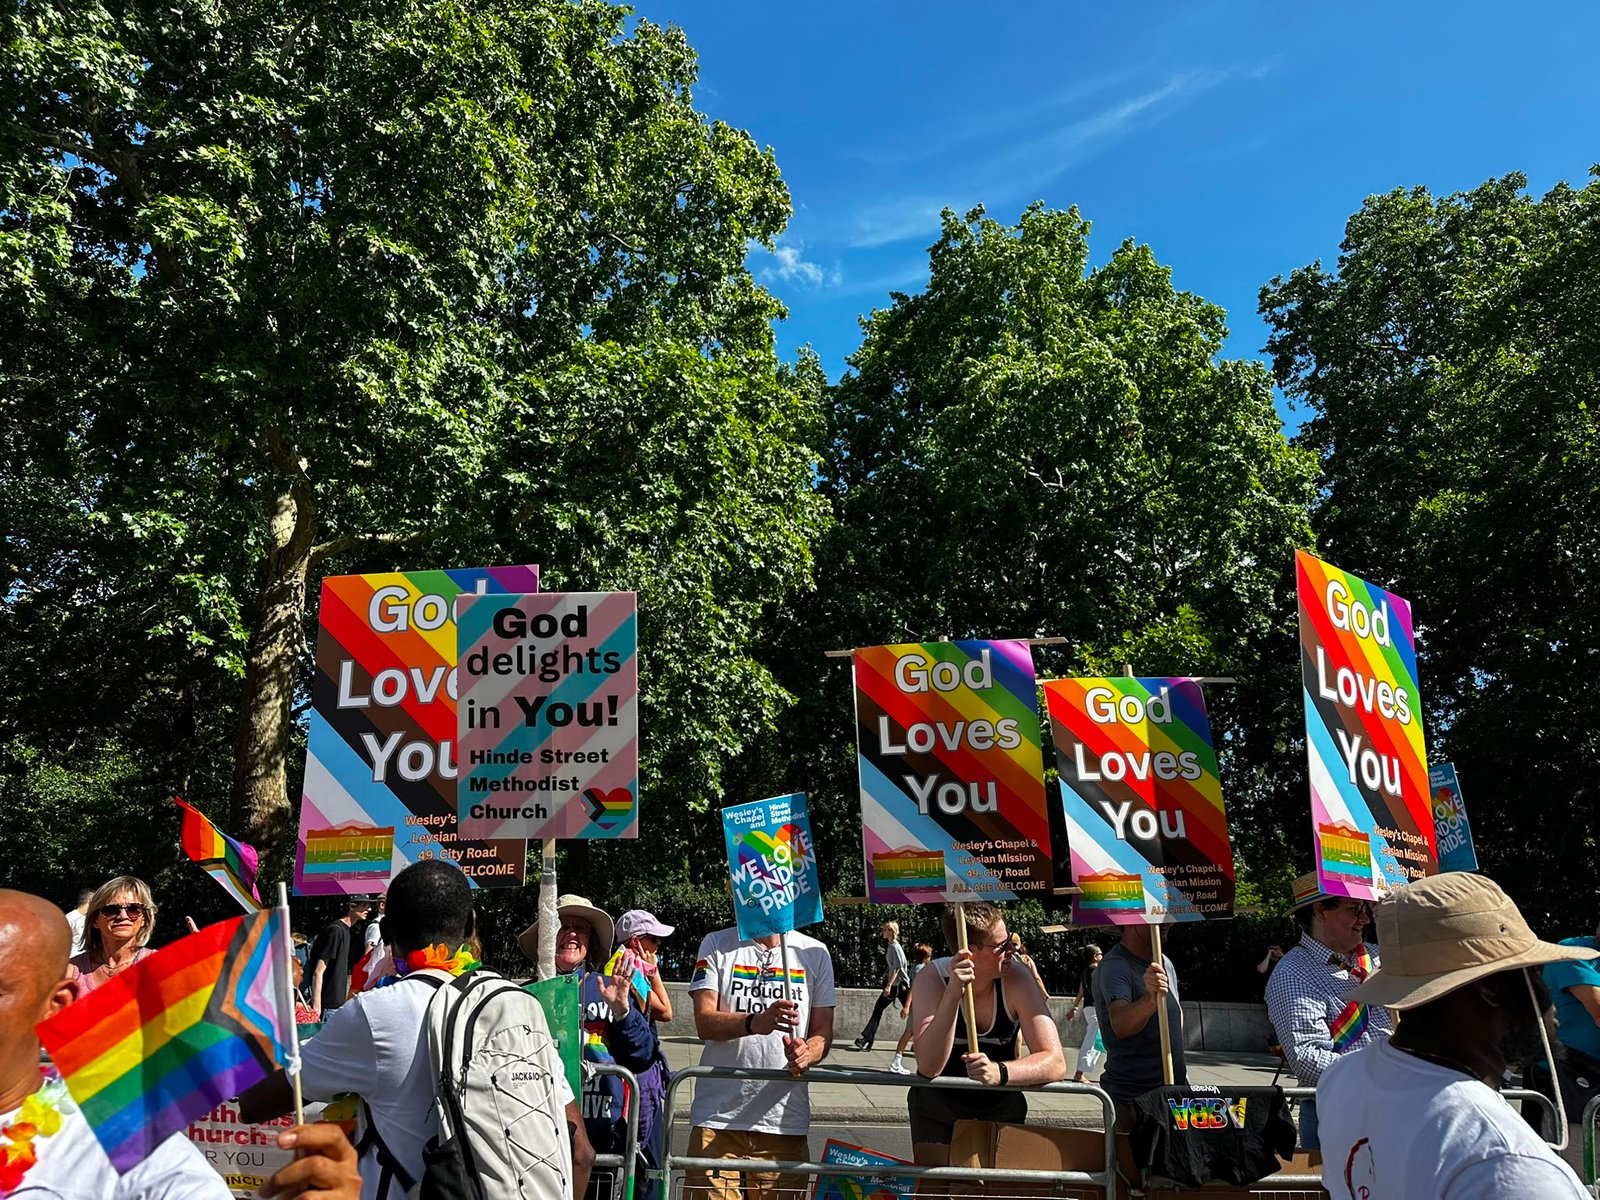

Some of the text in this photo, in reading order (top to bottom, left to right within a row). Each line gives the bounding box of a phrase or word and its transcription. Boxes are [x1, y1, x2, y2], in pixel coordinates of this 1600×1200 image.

[492, 605, 588, 639] God
[1326, 579, 1391, 649] God
[466, 644, 622, 683] delights
[894, 648, 993, 694] God
[1316, 645, 1412, 726] Loves
[467, 695, 619, 729] in You!
[1084, 686, 1174, 725] God
[878, 715, 1022, 756] Loves
[469, 748, 609, 765] Hinde Street
[1072, 742, 1203, 782] Loves
[1336, 727, 1403, 798] You
[469, 775, 579, 792] Methodist
[902, 774, 998, 816] You
[469, 803, 548, 820] Church
[725, 806, 763, 820] Wesley's
[769, 802, 789, 811] Hinde
[770, 808, 791, 818] Street
[405, 813, 457, 827] Wesley's
[734, 813, 765, 825] Chapel
[750, 820, 766, 829] and
[771, 812, 805, 825] Methodist
[1098, 799, 1187, 841] You
[412, 831, 457, 845] Leysian
[1374, 825, 1429, 847] Wesley's Chapel &
[439, 849, 463, 861] City
[467, 846, 497, 859] Road
[951, 839, 1038, 851] Wesley's Chapel &
[731, 830, 813, 886] WE LOVE
[959, 853, 1035, 866] Leysian Mission
[1404, 848, 1428, 863] Mission
[461, 863, 515, 876] ELCOME
[735, 849, 817, 906] LONDON
[983, 868, 1003, 879] City
[1005, 867, 1030, 877] Road
[1147, 864, 1223, 876] Wesley's Chapel &
[1396, 864, 1409, 879] City
[1409, 866, 1426, 879] Road
[952, 881, 1046, 893] ALL ARE WELCOME
[1189, 878, 1222, 887] Mission
[759, 875, 811, 916] PRIDE
[1178, 892, 1195, 901] City
[1196, 891, 1217, 899] Road
[1170, 905, 1185, 913] ARE
[1187, 903, 1229, 912] WELCOME
[731, 981, 783, 999] Proud
[1168, 1097, 1247, 1130] ABBA
[188, 1123, 267, 1145] hurch
[223, 1151, 265, 1166] YOU
[829, 1147, 869, 1164] Wesley's
